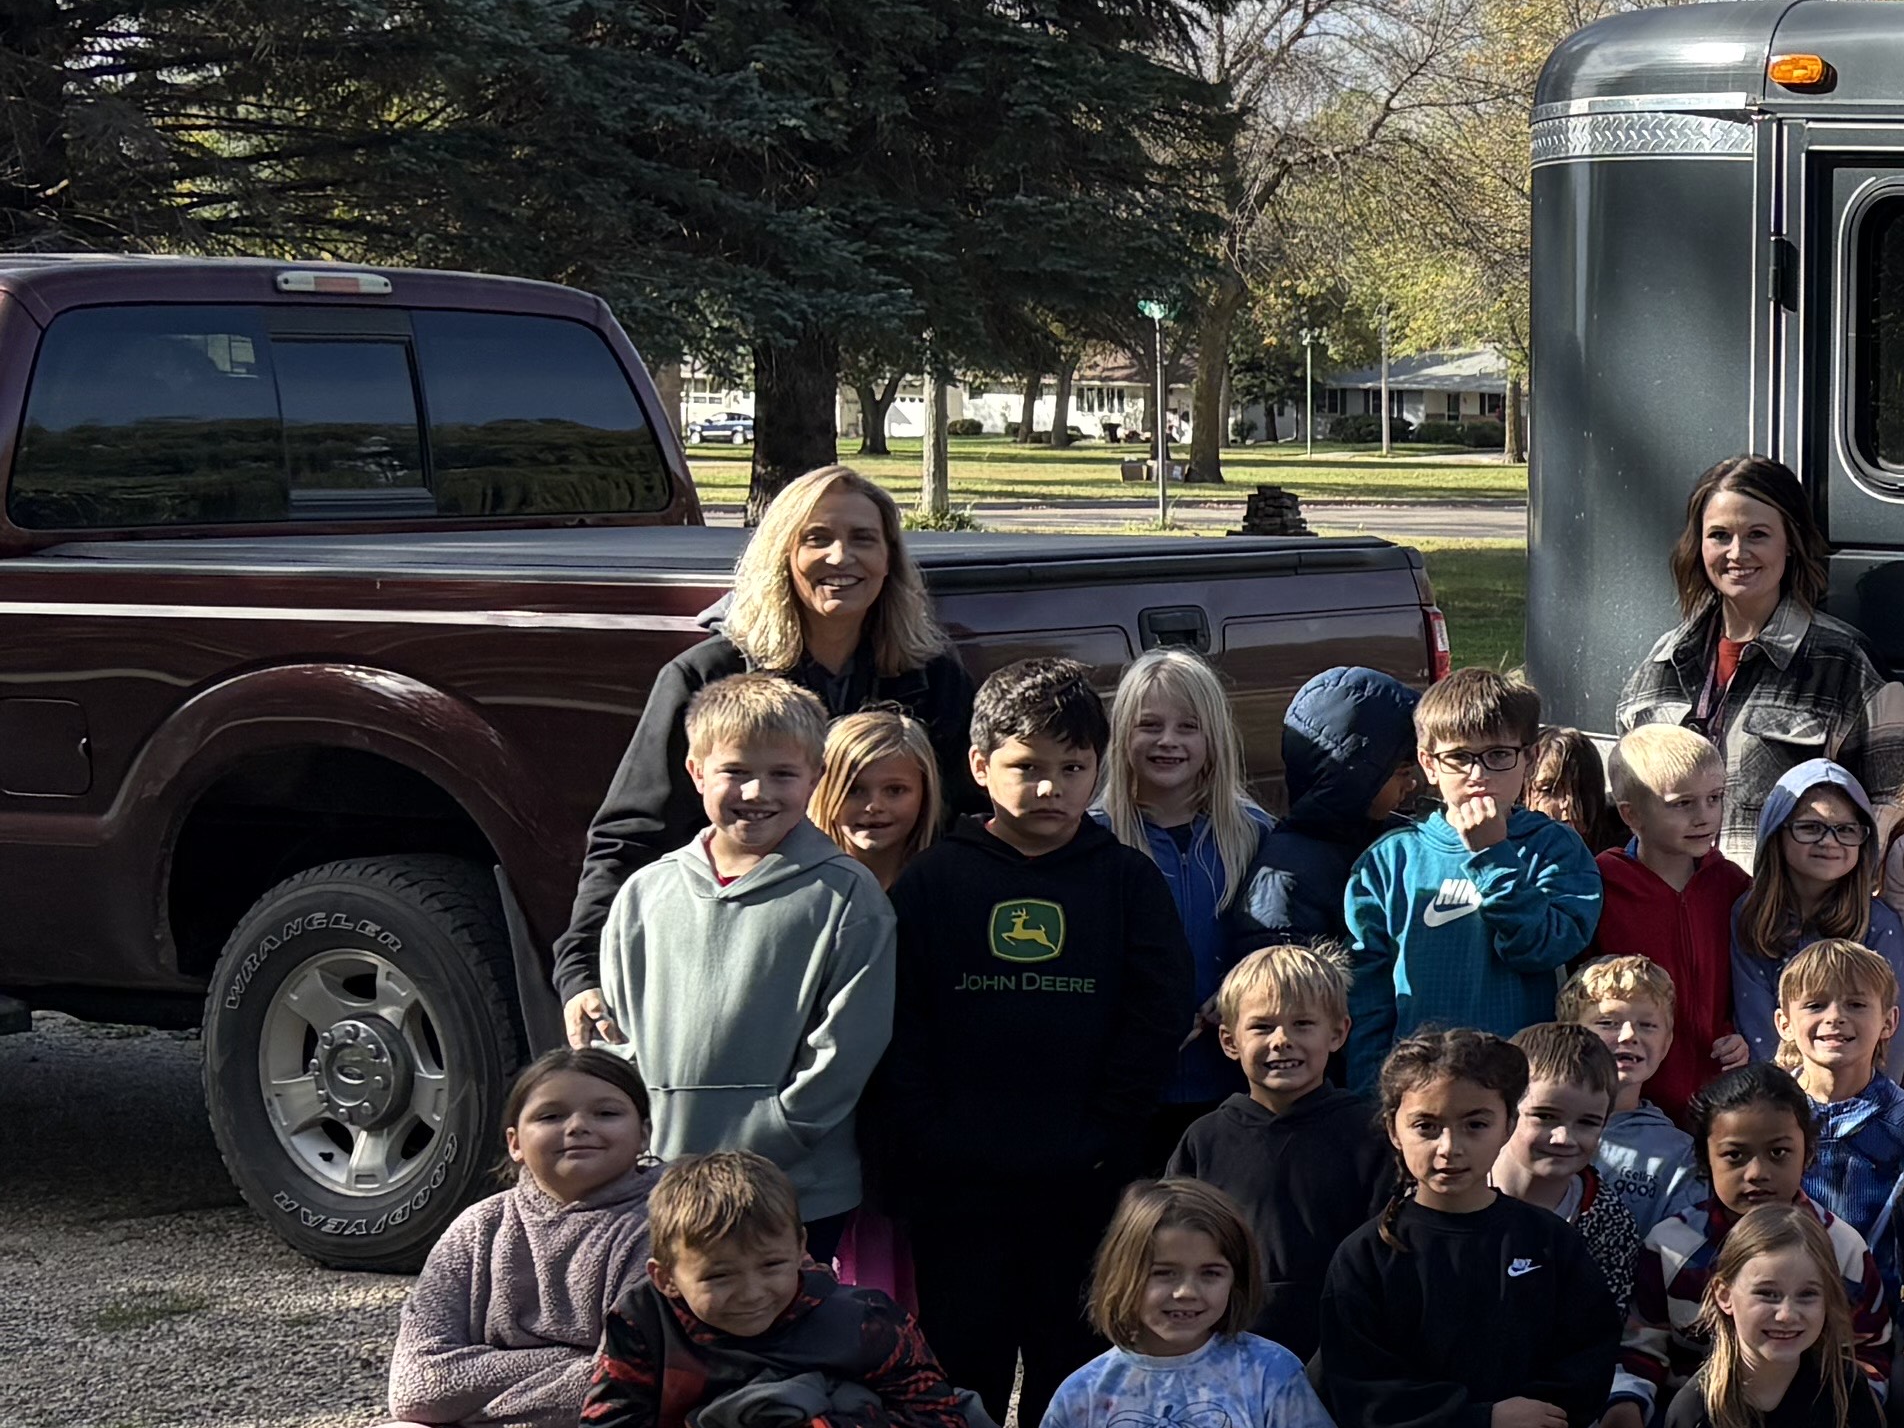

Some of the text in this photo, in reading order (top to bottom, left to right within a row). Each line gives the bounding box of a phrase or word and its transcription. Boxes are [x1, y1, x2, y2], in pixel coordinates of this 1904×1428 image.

[226, 913, 403, 1010] WRANGLER
[954, 972, 1096, 993] JOHN DEERE
[273, 1132, 458, 1236] GOODYEAR
